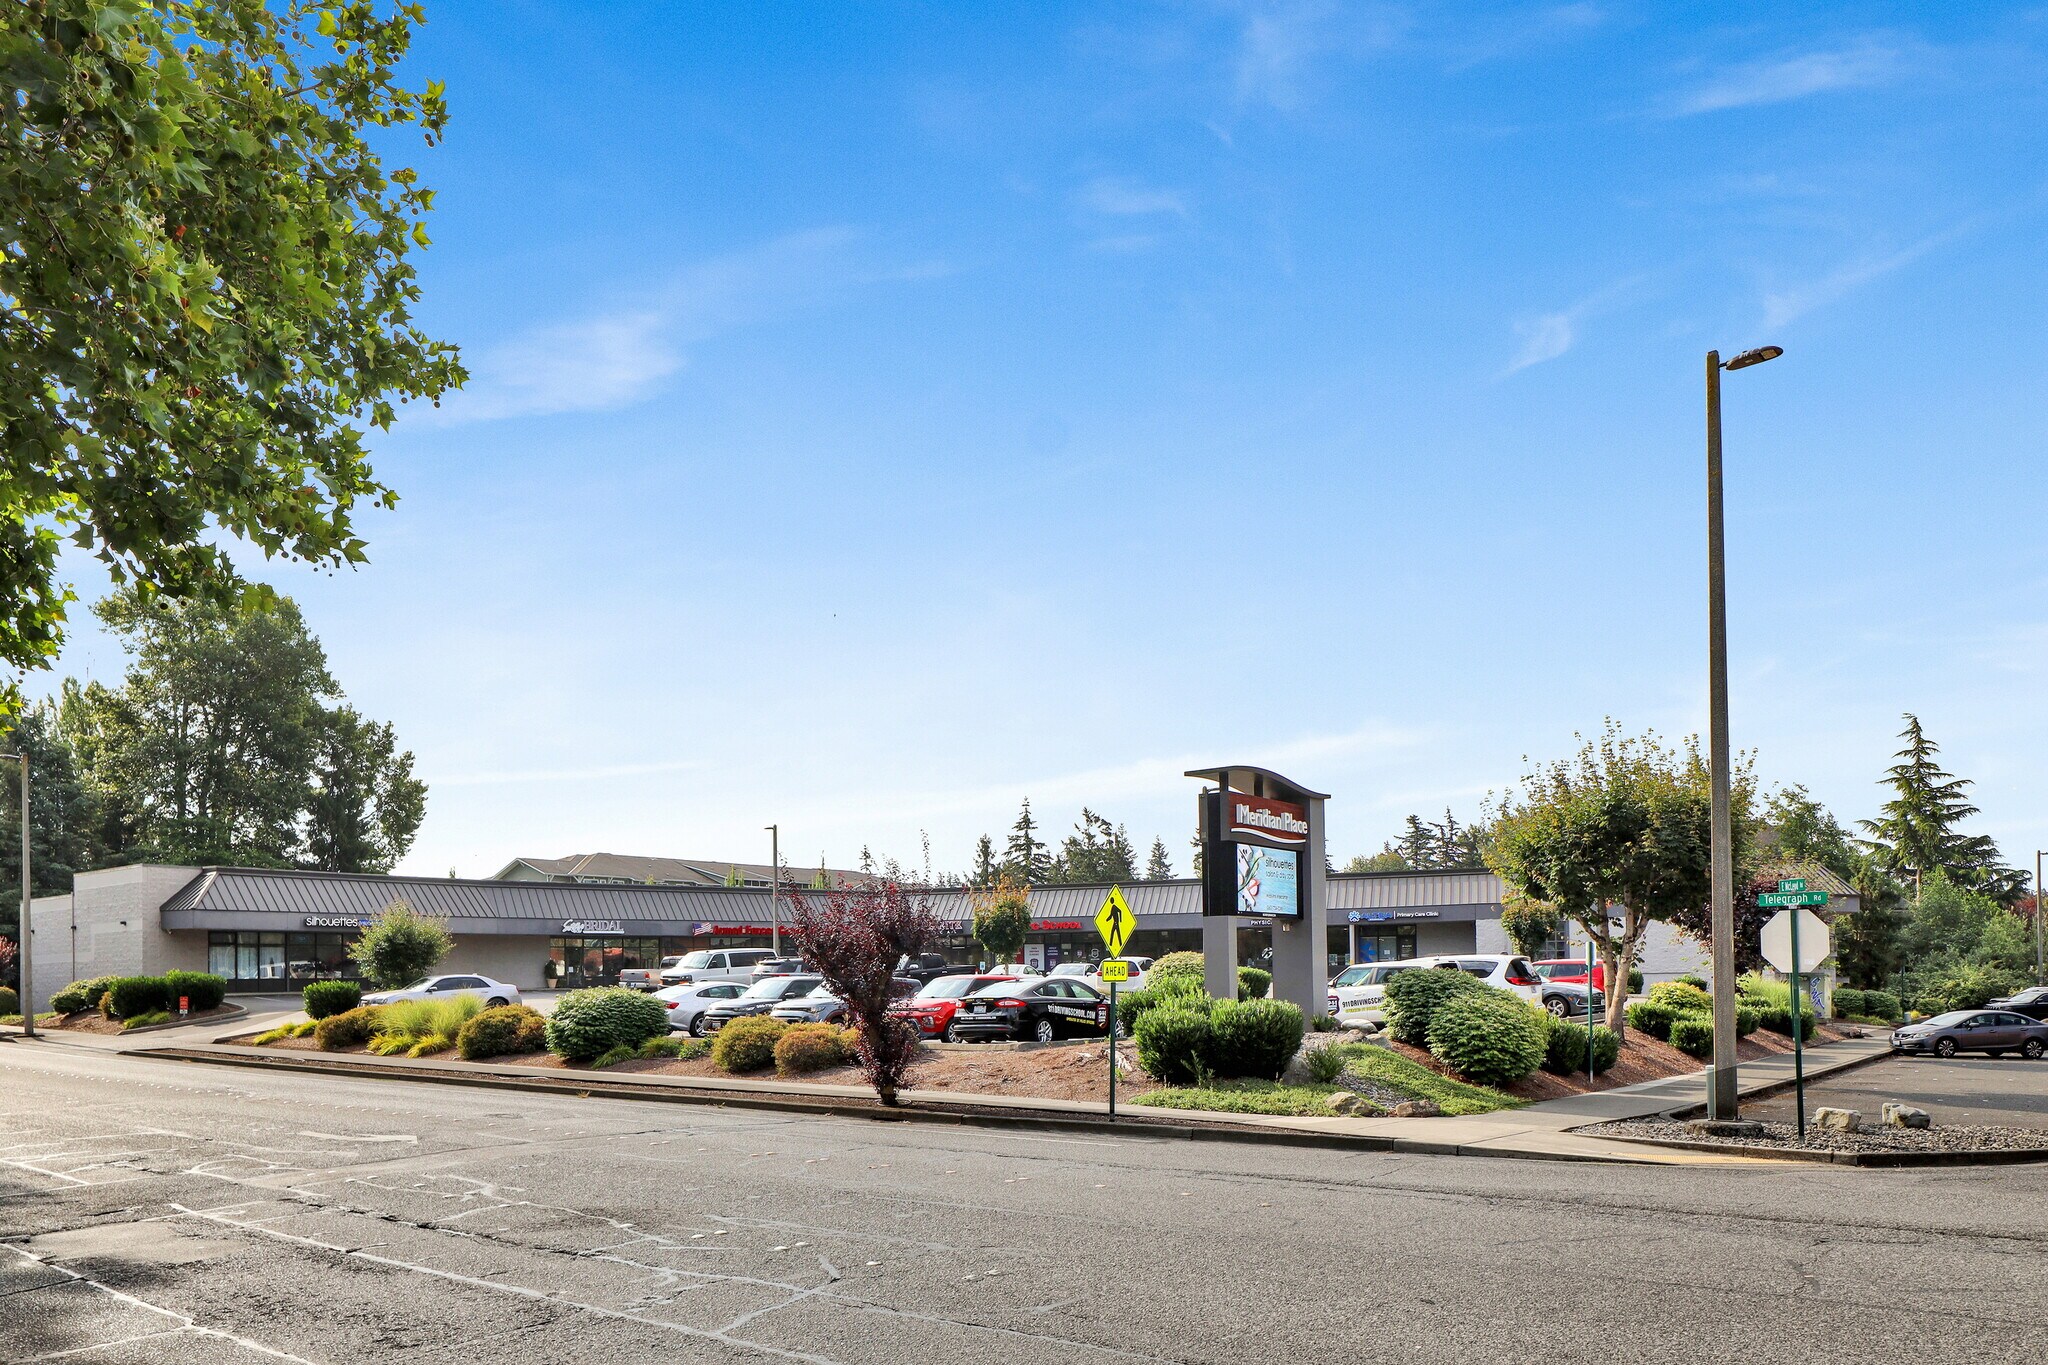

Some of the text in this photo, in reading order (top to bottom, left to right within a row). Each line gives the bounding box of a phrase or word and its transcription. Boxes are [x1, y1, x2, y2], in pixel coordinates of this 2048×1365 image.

[1236, 803, 1308, 834] Meridian Place
[1764, 893, 1822, 905] Telegraph Rd
[306, 915, 358, 927] silhouettes
[584, 920, 624, 931] BRIDAL
[1105, 965, 1126, 977] AHEAD
